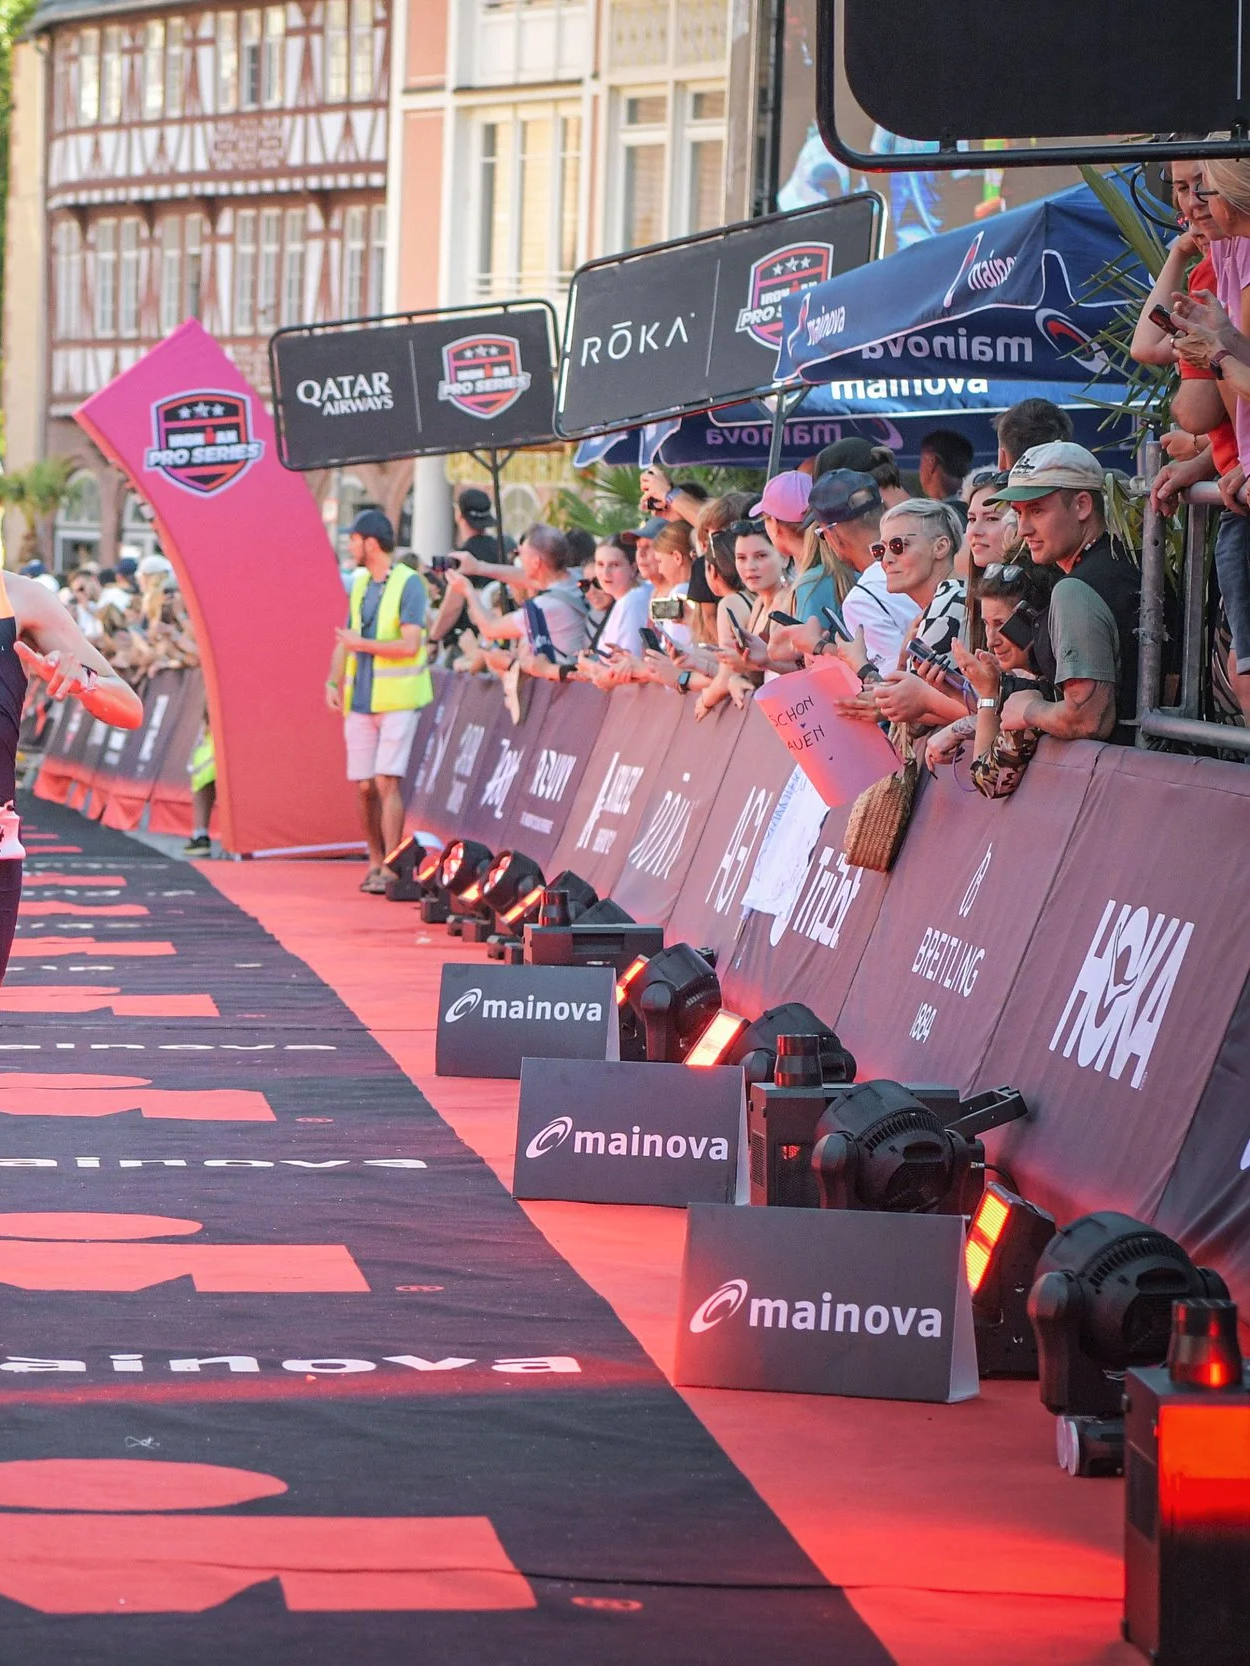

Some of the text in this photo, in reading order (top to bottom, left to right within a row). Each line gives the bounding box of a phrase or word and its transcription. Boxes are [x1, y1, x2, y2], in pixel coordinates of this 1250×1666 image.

[740, 305, 776, 328] PRO
[807, 305, 846, 346] mainova
[296, 371, 393, 408] QATAR
[322, 394, 394, 416] AIRWAYS
[148, 443, 261, 467] PRO SERIES
[911, 927, 986, 999] BREITLING
[482, 994, 603, 1023] mainova
[1049, 899, 1195, 1091] HOKA
[908, 1002, 938, 1044] 1884
[574, 1125, 729, 1161] mainova
[749, 1290, 943, 1339] mainova
